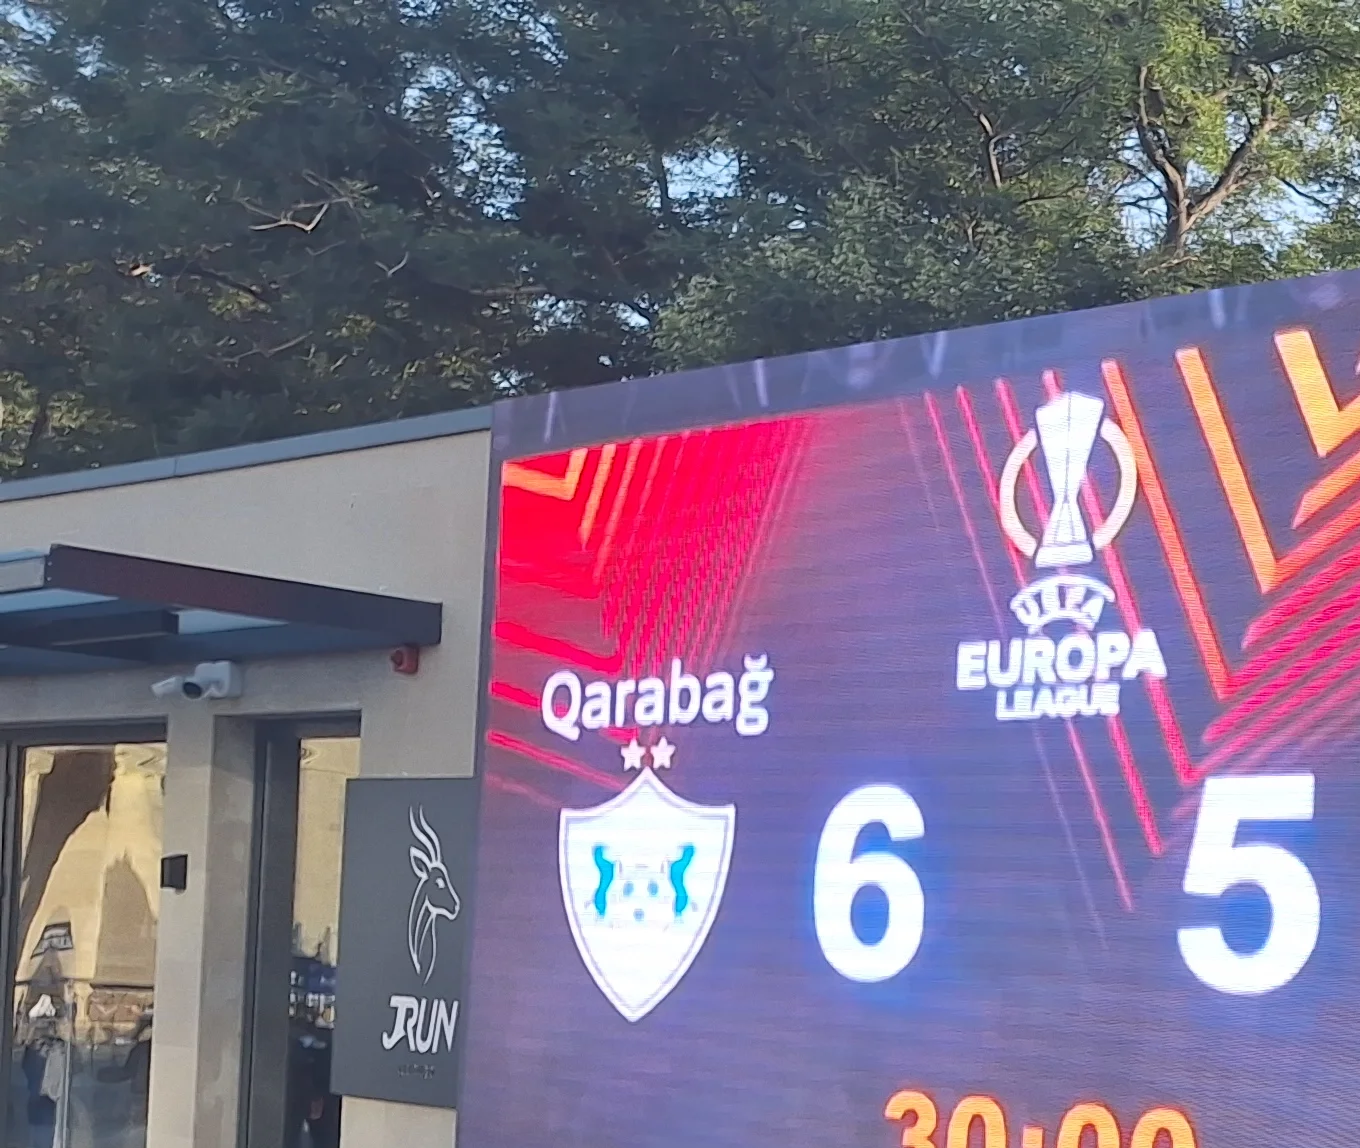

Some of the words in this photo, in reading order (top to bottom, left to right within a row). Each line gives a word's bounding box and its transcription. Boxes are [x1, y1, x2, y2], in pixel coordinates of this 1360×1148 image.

[541, 652, 775, 742] Qarabağ
[956, 628, 1168, 691] EUROPA
[994, 682, 1121, 721] LEAGUE
[813, 783, 926, 983] 6
[1176, 772, 1321, 996] 5
[381, 995, 460, 1054] JRUN
